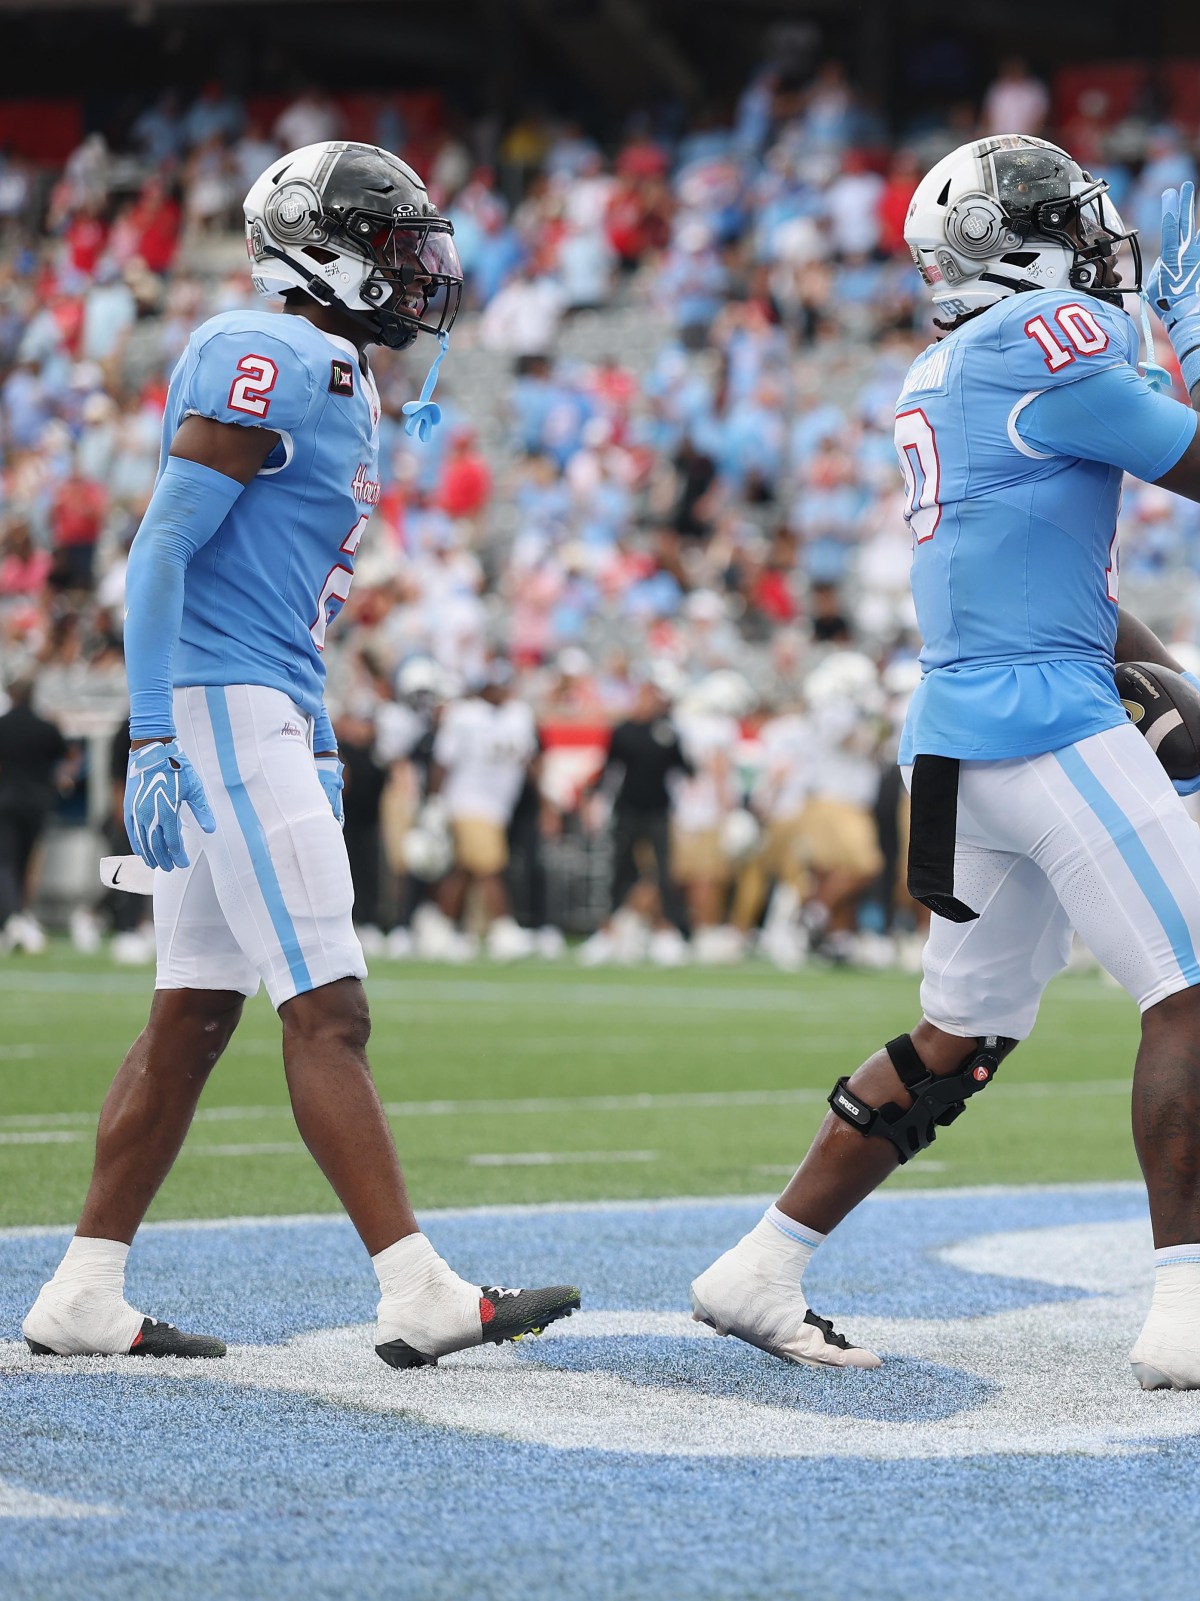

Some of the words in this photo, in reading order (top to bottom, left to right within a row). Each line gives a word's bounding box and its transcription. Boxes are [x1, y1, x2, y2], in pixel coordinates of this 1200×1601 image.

[1023, 302, 1110, 375] 10
[227, 353, 279, 419] 2
[838, 1094, 860, 1116] BREG
